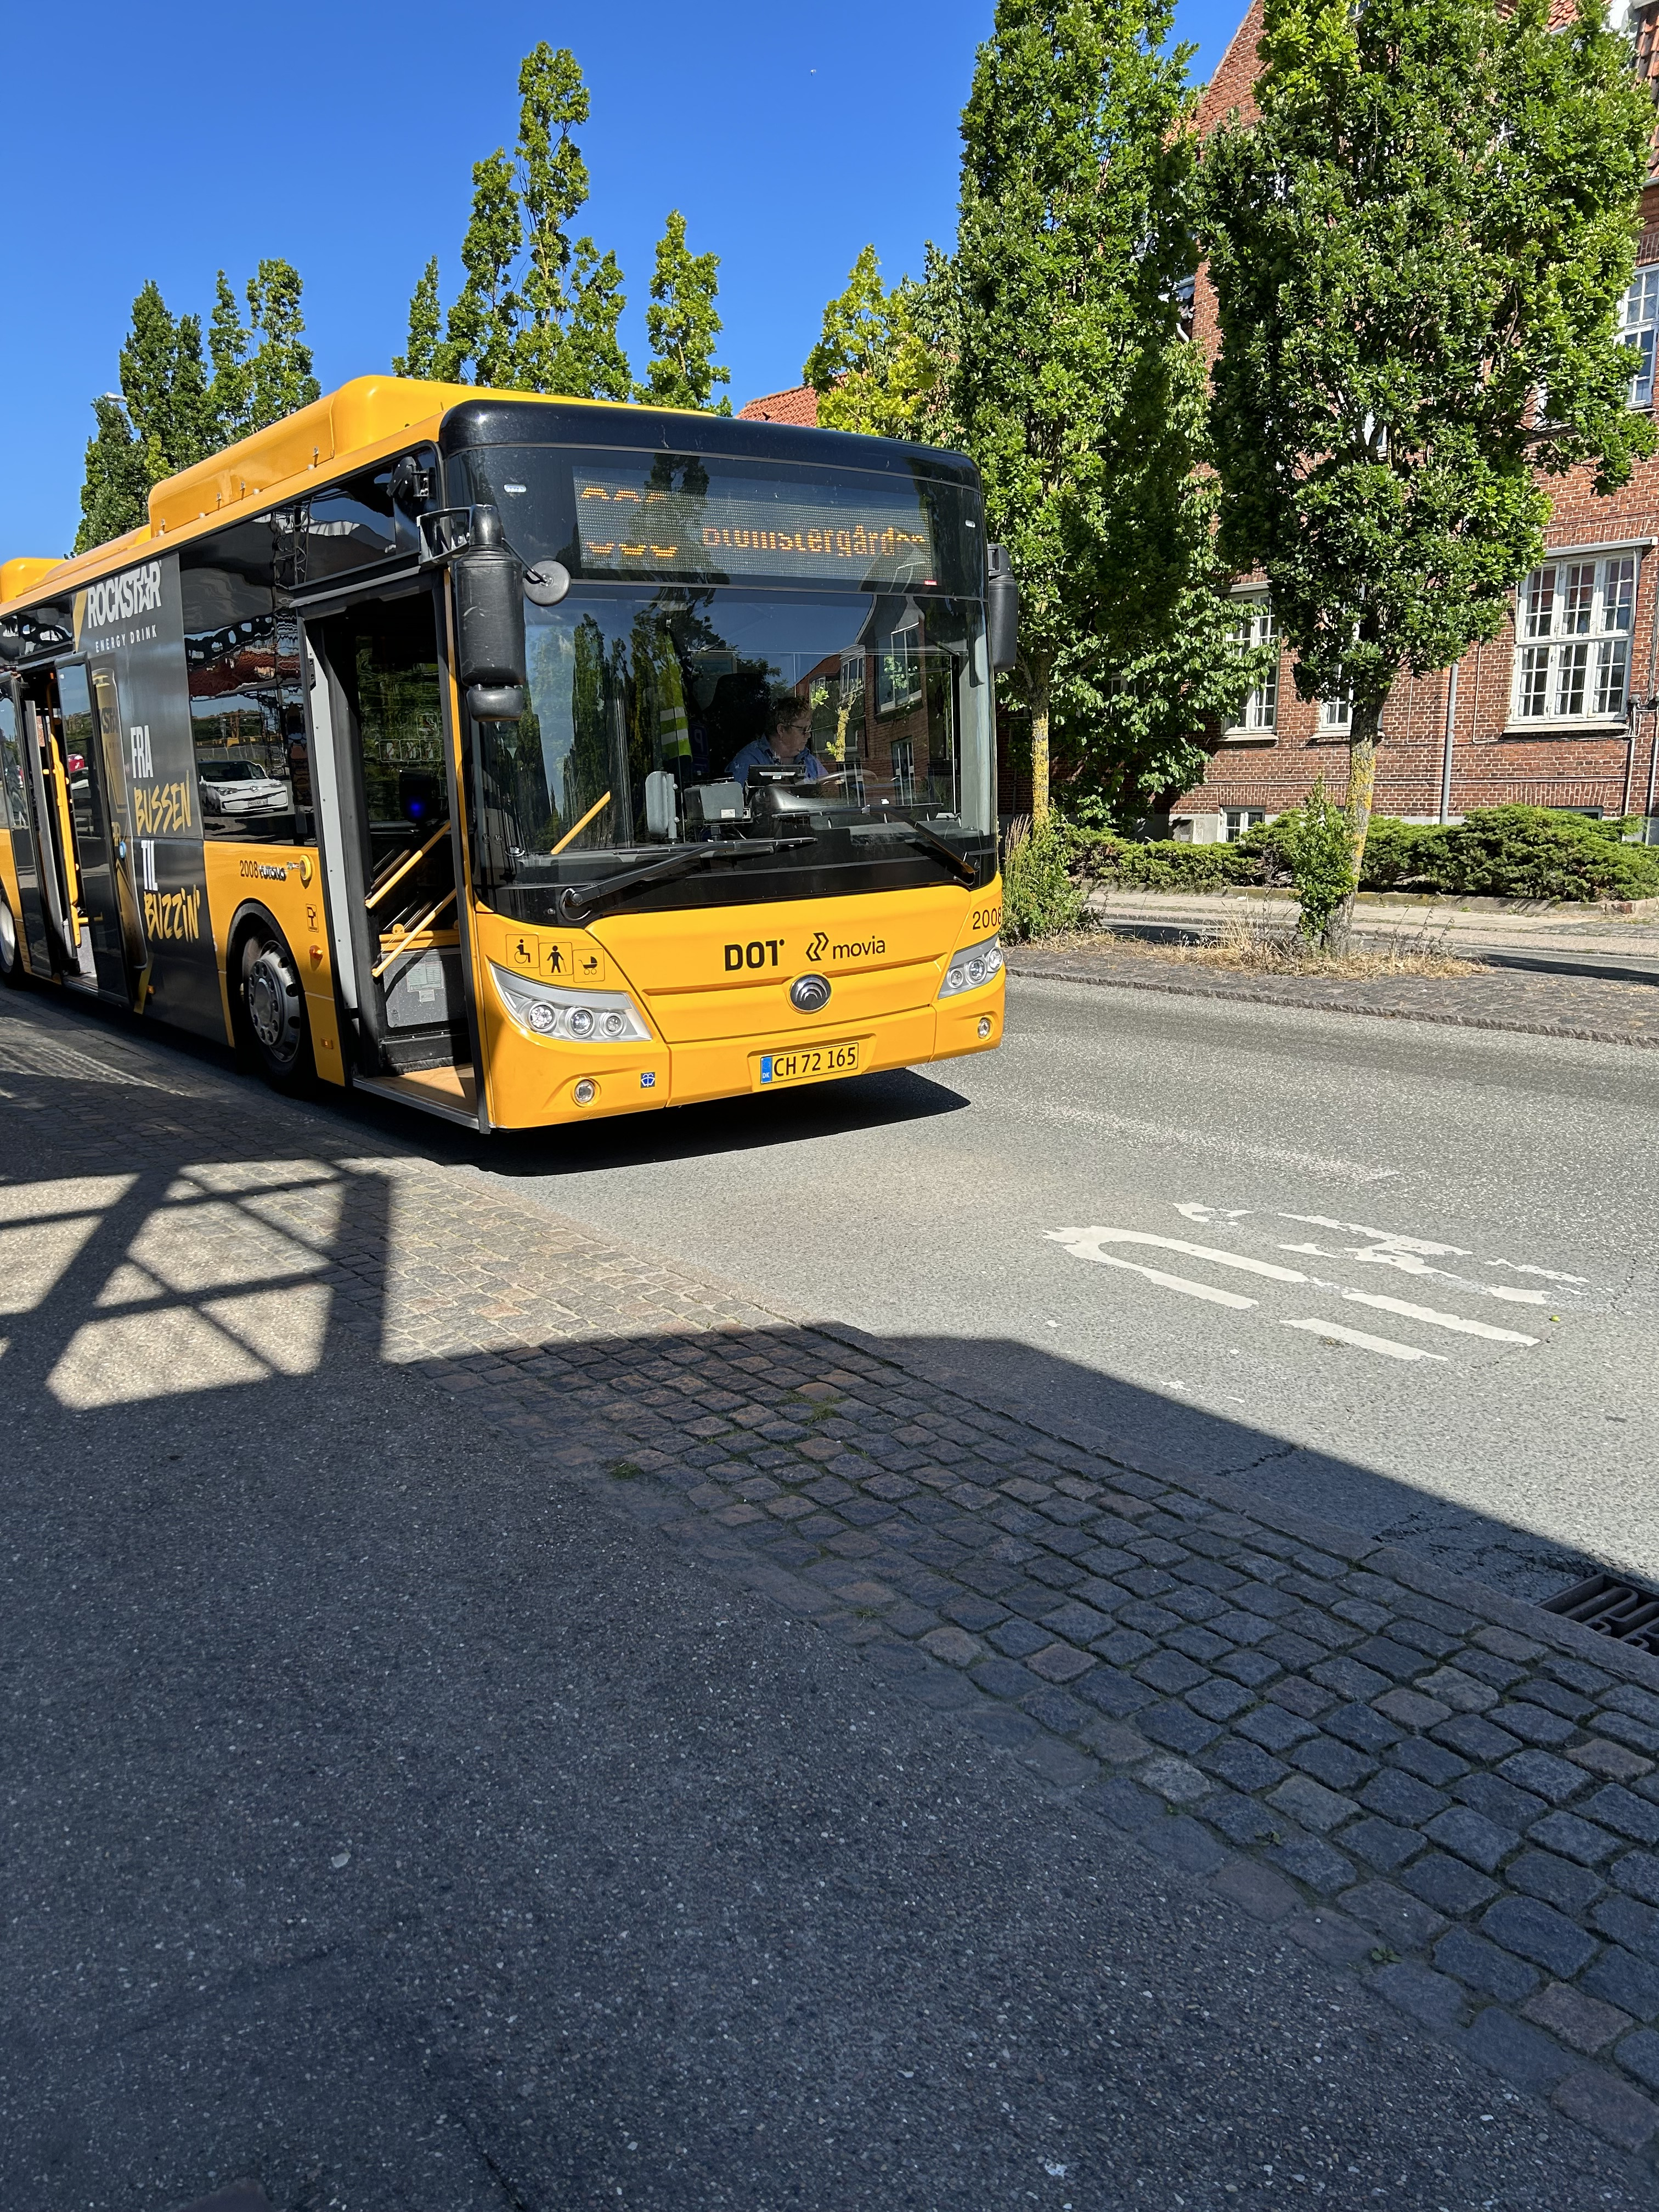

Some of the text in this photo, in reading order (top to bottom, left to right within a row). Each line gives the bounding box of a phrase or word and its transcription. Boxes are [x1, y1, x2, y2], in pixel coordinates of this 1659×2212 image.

[88, 561, 161, 629] ROCKSTAR
[95, 624, 157, 653] ENERGY DRINK
[131, 725, 154, 779] FRA
[134, 769, 191, 836] BUSSEN
[141, 839, 159, 891] TIL
[240, 860, 258, 878] 2008
[972, 906, 1002, 930] 2008
[724, 935, 885, 972] DOT movia
[774, 1047, 856, 1077] CH 72 165
